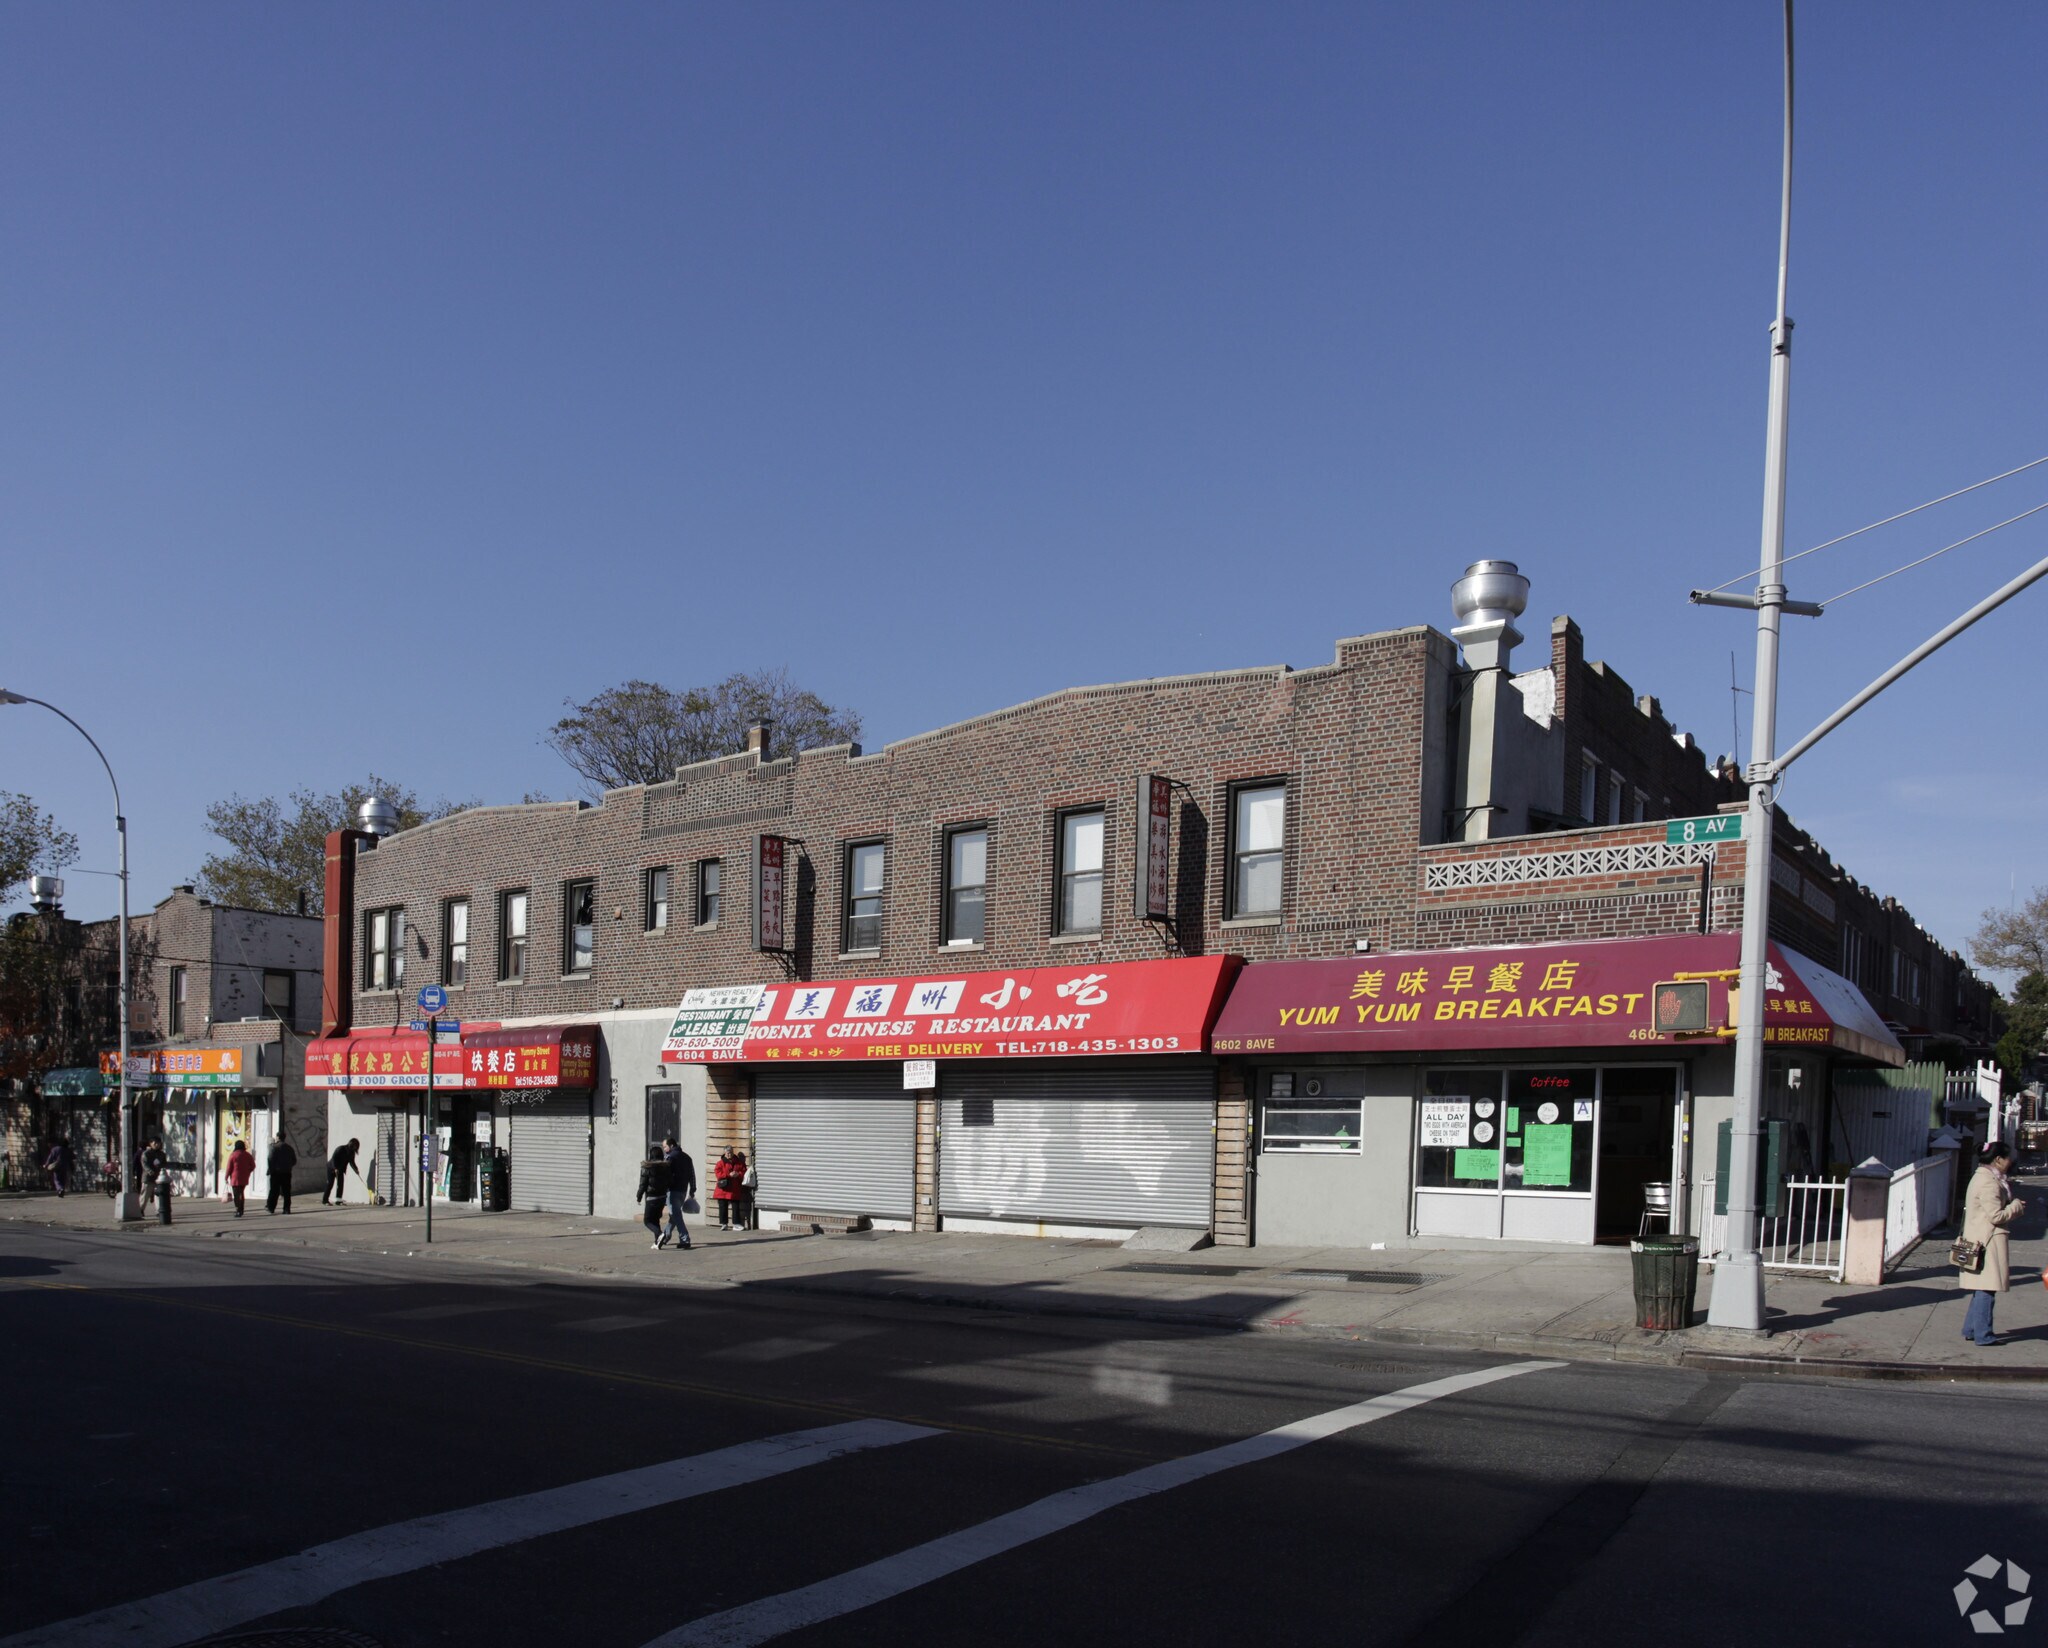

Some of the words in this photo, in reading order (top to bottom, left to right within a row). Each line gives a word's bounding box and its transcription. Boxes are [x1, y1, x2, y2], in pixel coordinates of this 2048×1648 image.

[1683, 821, 1695, 842] 8
[1705, 818, 1727, 833] AV
[1349, 959, 1580, 999] 美味早餐店
[678, 1010, 732, 1021] RESTAURANT
[1279, 1006, 1340, 1026] YUM
[1356, 1002, 1422, 1023] YUM
[1433, 993, 1644, 1020] BREAKFAST
[672, 1024, 687, 1036] FOR
[685, 1021, 725, 1036] LEASE
[725, 1023, 747, 1035] 出租
[826, 1020, 916, 1038] CHINESE
[928, 1013, 1091, 1037] RESTAURANT
[1778, 1027, 1829, 1041] BREAKFAST
[667, 1037, 740, 1048] 718-630-5009
[996, 1037, 1179, 1054] TEL:718-435-1303
[1214, 1040, 1241, 1050] 4602
[1246, 1038, 1275, 1049] 8AVE
[520, 1047, 536, 1057] Yummy
[536, 1046, 550, 1056] Street
[562, 1042, 592, 1058] 快餐店
[676, 1050, 705, 1060] 4604
[712, 1049, 747, 1060] 8AVE.
[867, 1044, 902, 1056] FREE
[908, 1043, 983, 1055] DELIVERY
[471, 1049, 516, 1073] 快餐店
[327, 1075, 354, 1085] BABY
[359, 1075, 386, 1085] FOOD
[391, 1075, 442, 1085] GROCEY
[465, 1077, 477, 1087] 4610
[1530, 1076, 1570, 1088] Coffee
[1577, 1101, 1589, 1115] A
[1426, 1113, 1443, 1121] ALL
[1447, 1113, 1465, 1121] DAY
